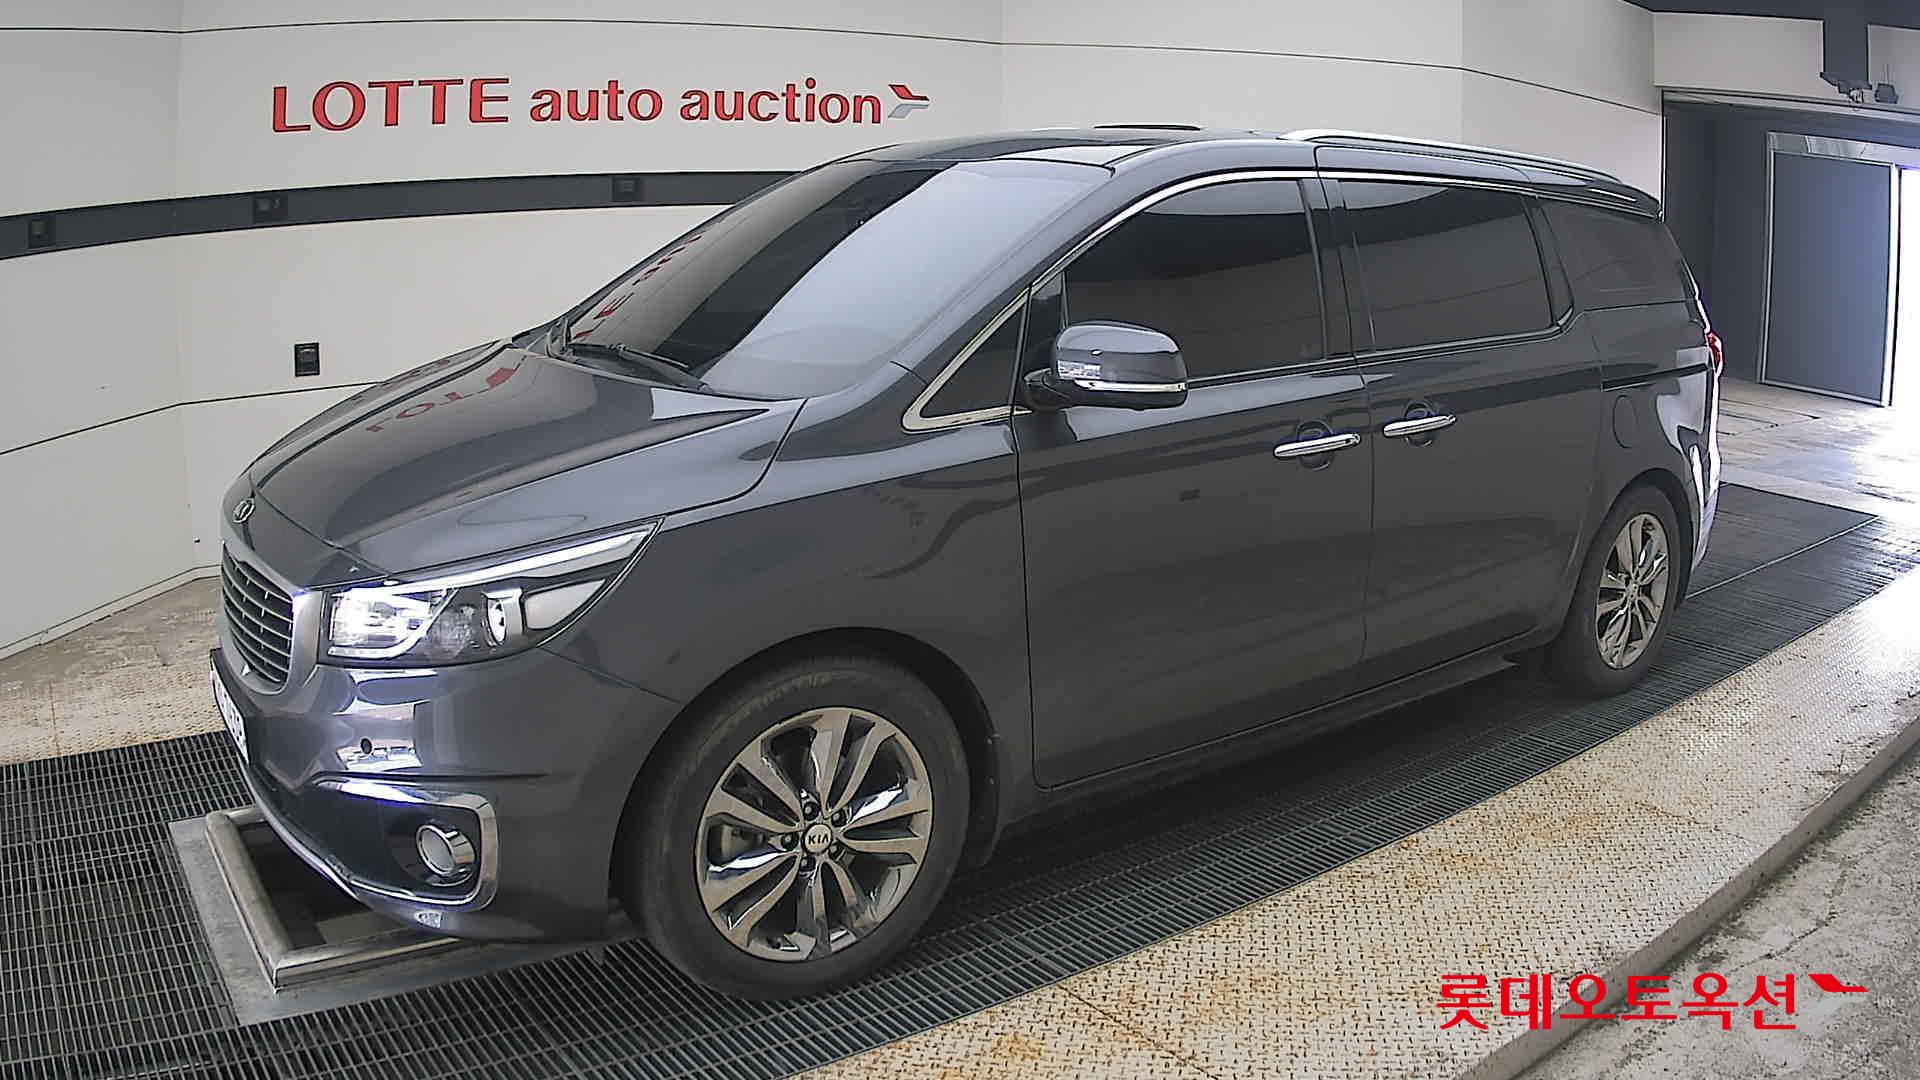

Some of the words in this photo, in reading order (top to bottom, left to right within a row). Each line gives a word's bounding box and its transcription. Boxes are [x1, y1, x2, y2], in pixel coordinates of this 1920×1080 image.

[271, 79, 509, 133] LOTTE
[529, 80, 664, 124] auto
[680, 78, 882, 124] auction
[808, 834, 829, 845] KIA
